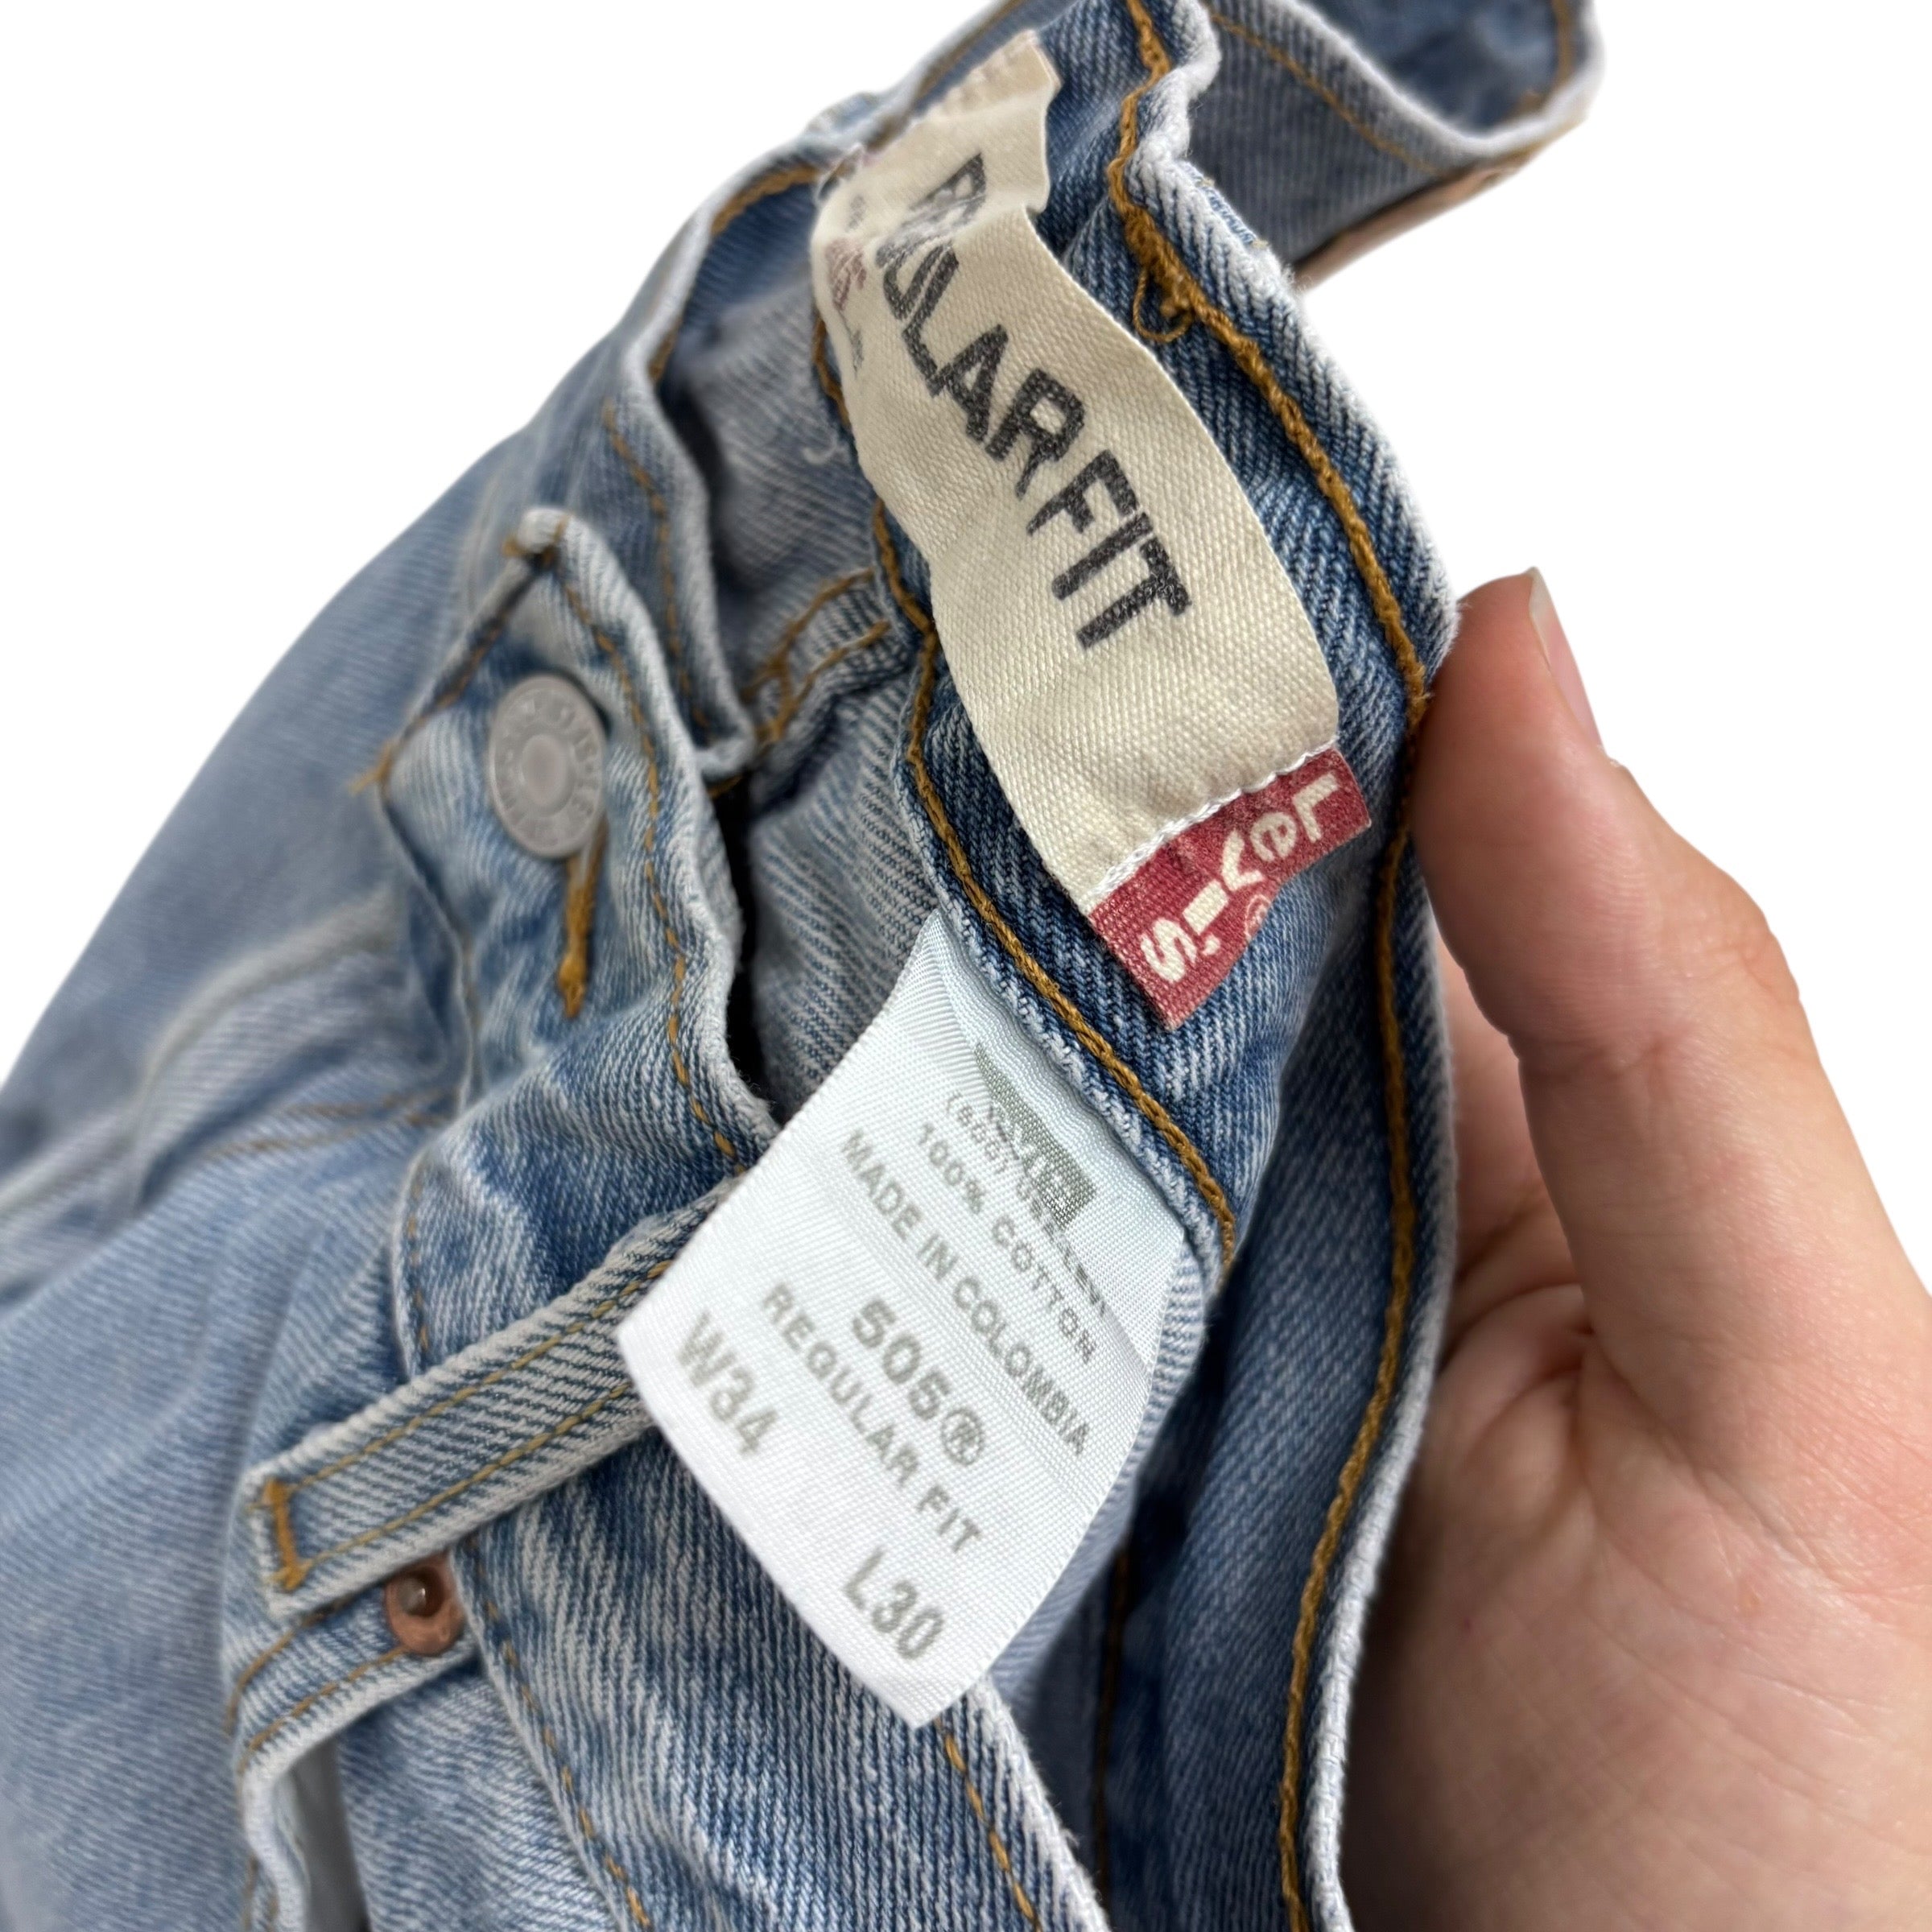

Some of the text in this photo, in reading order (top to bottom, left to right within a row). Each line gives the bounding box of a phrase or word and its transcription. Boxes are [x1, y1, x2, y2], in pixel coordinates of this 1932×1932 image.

[1026, 449, 1191, 647] FIT
[842, 1130, 919, 1241] MADE
[922, 1236, 957, 1285] IN
[953, 1277, 1090, 1454] COLOMBIA
[919, 1123, 985, 1214] 100%
[991, 1216, 1097, 1362] COTTON
[678, 1312, 945, 1661] W34 L30
[762, 1283, 981, 1554] REGULAR FIT
